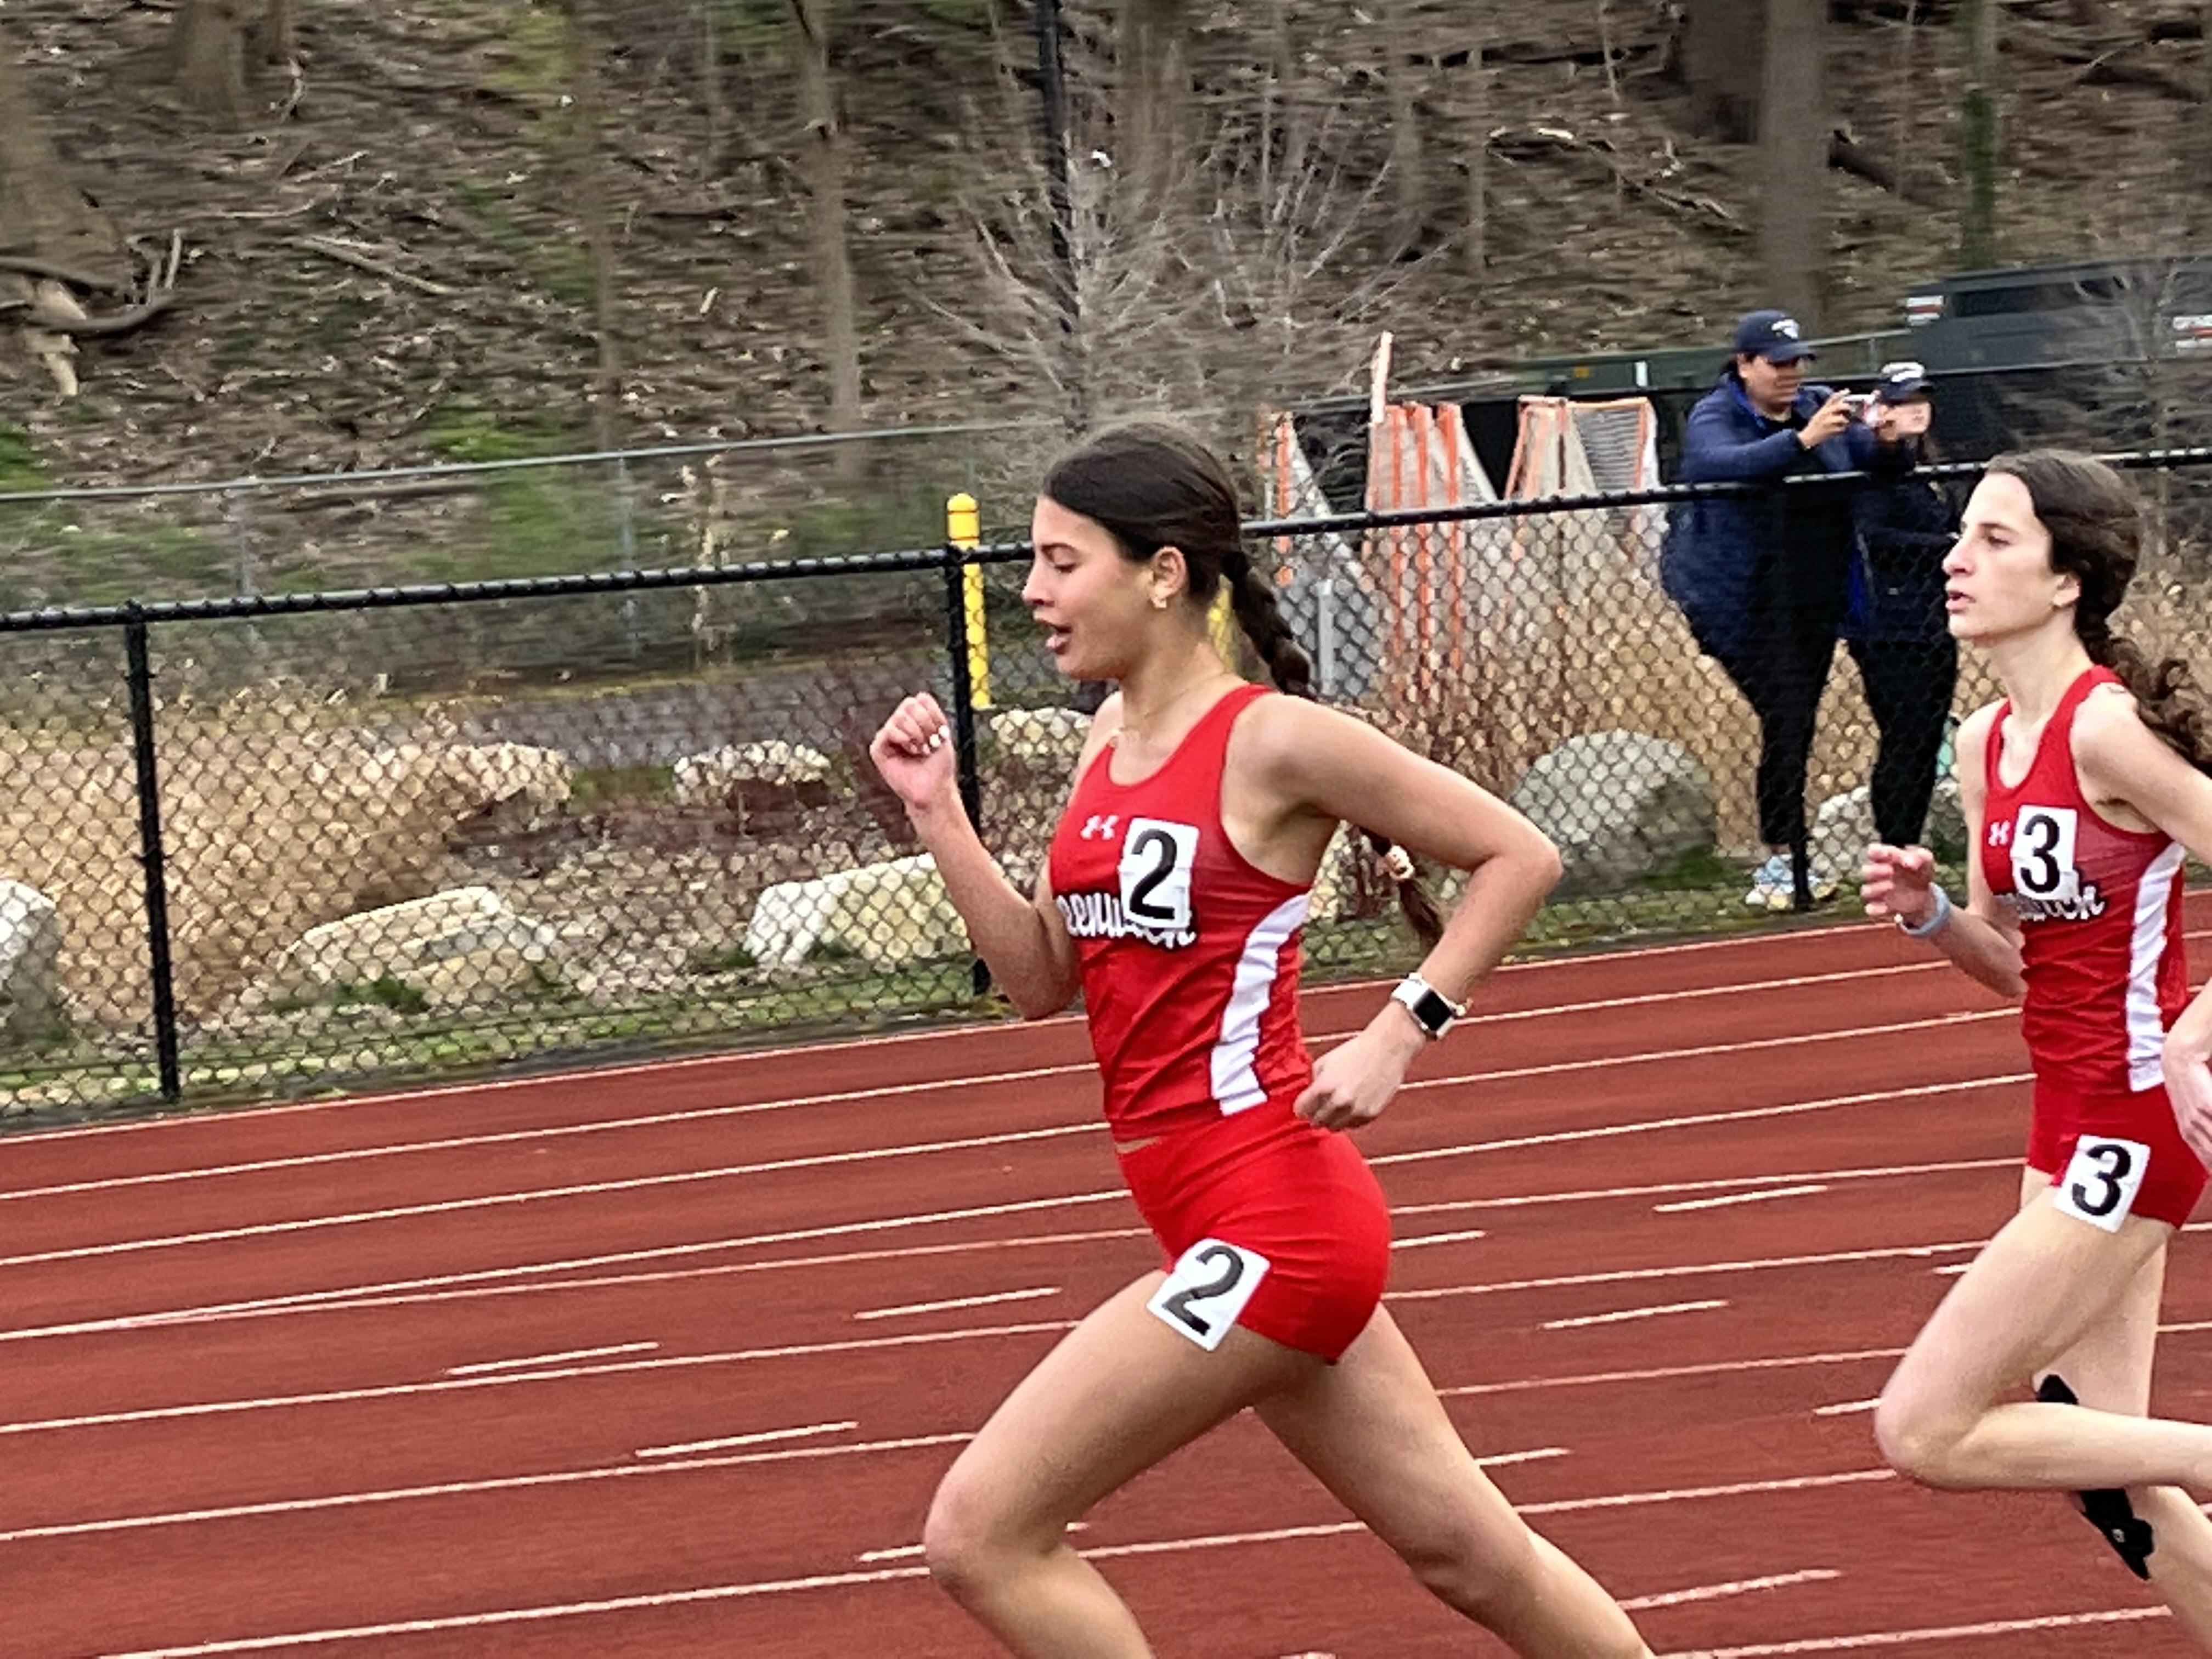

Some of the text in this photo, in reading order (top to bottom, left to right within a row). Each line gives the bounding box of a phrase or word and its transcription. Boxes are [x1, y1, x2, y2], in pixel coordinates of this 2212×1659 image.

[1129, 828, 1178, 920] 2
[2020, 814, 2061, 894] 3
[2072, 1144, 2131, 1217] 3
[1161, 1245, 1244, 1336] 2
